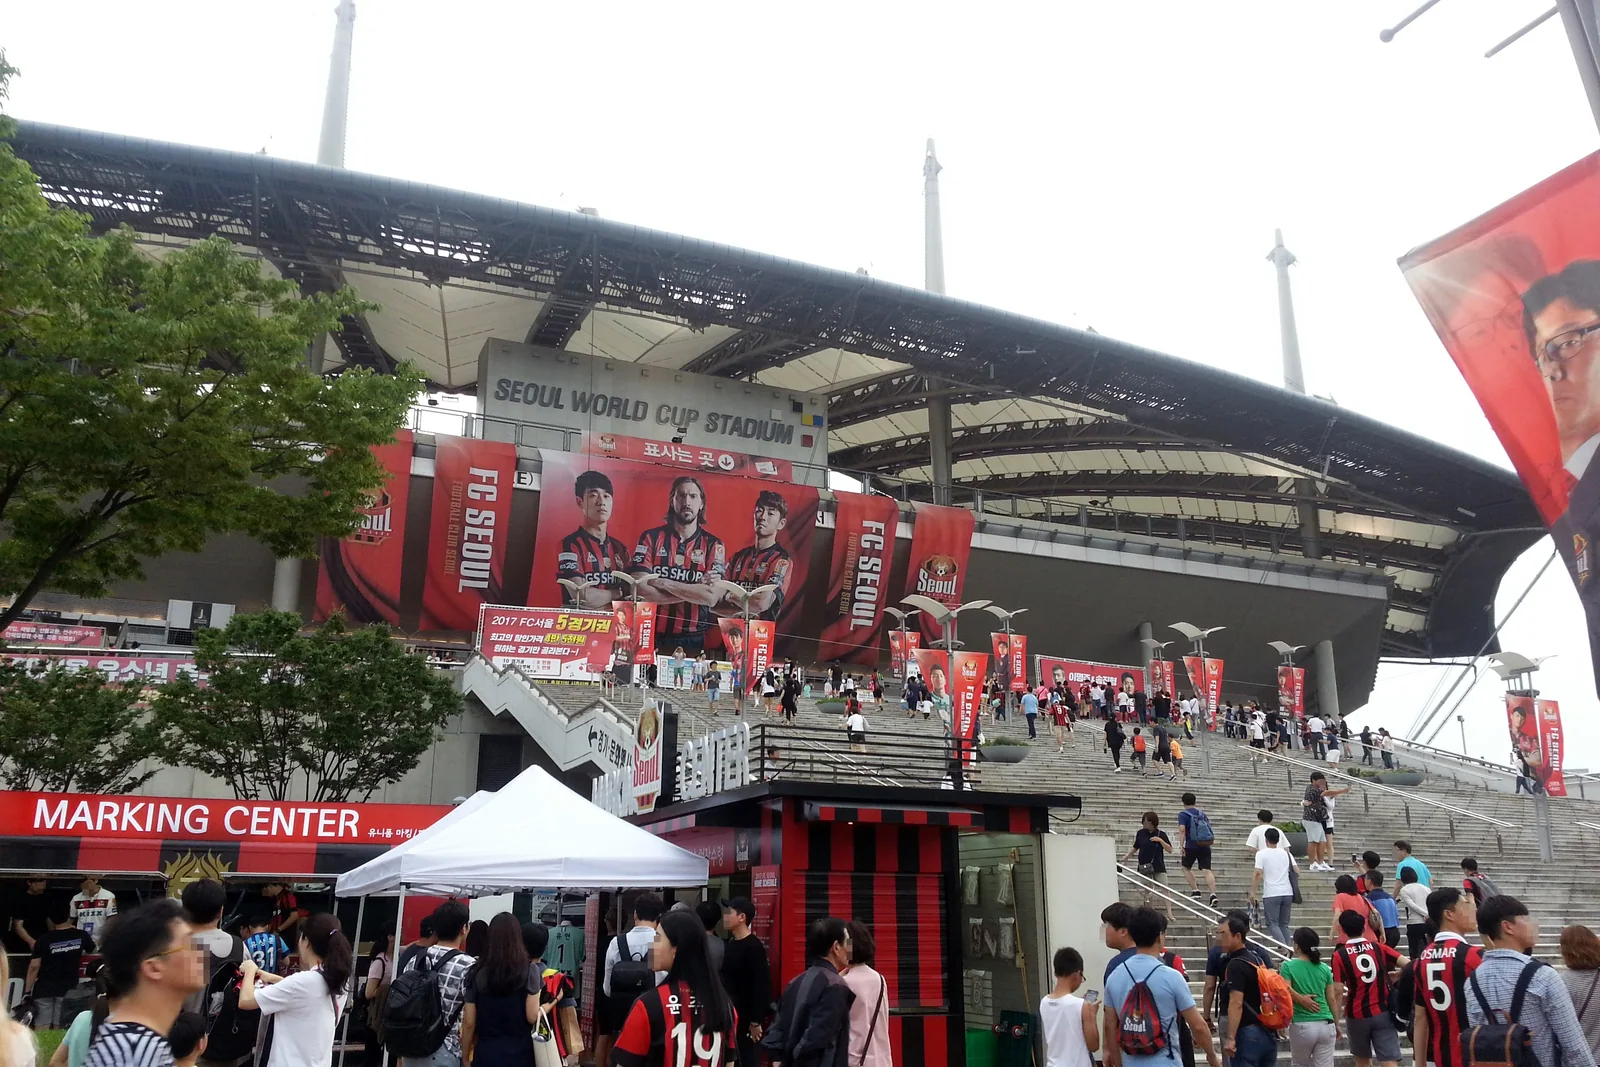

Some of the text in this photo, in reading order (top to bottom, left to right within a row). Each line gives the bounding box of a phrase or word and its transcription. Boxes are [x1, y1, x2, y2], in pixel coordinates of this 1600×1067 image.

[494, 378, 795, 445] SEOUL WORLD CUP STADIUM
[643, 442, 715, 468] 표사는 곳
[458, 466, 499, 593] FC SEOUL
[653, 566, 704, 582] GS SHOP
[850, 520, 885, 631] FC SEOUL
[916, 568, 957, 596] Seoul
[491, 613, 612, 634] 2017 FC서울 5경기권
[633, 740, 660, 788] Seoul
[680, 721, 750, 803] CENTER
[33, 798, 360, 838] MARKING CENTER
[368, 828, 424, 839] 유니폼 마킹/
[251, 946, 275, 970] 31
[557, 943, 565, 965] 1
[1346, 942, 1374, 956] DEJAN
[1420, 947, 1457, 960] OSMAR
[1355, 953, 1377, 984] 9
[1426, 962, 1451, 1012] 5
[670, 1021, 722, 1067] 19
